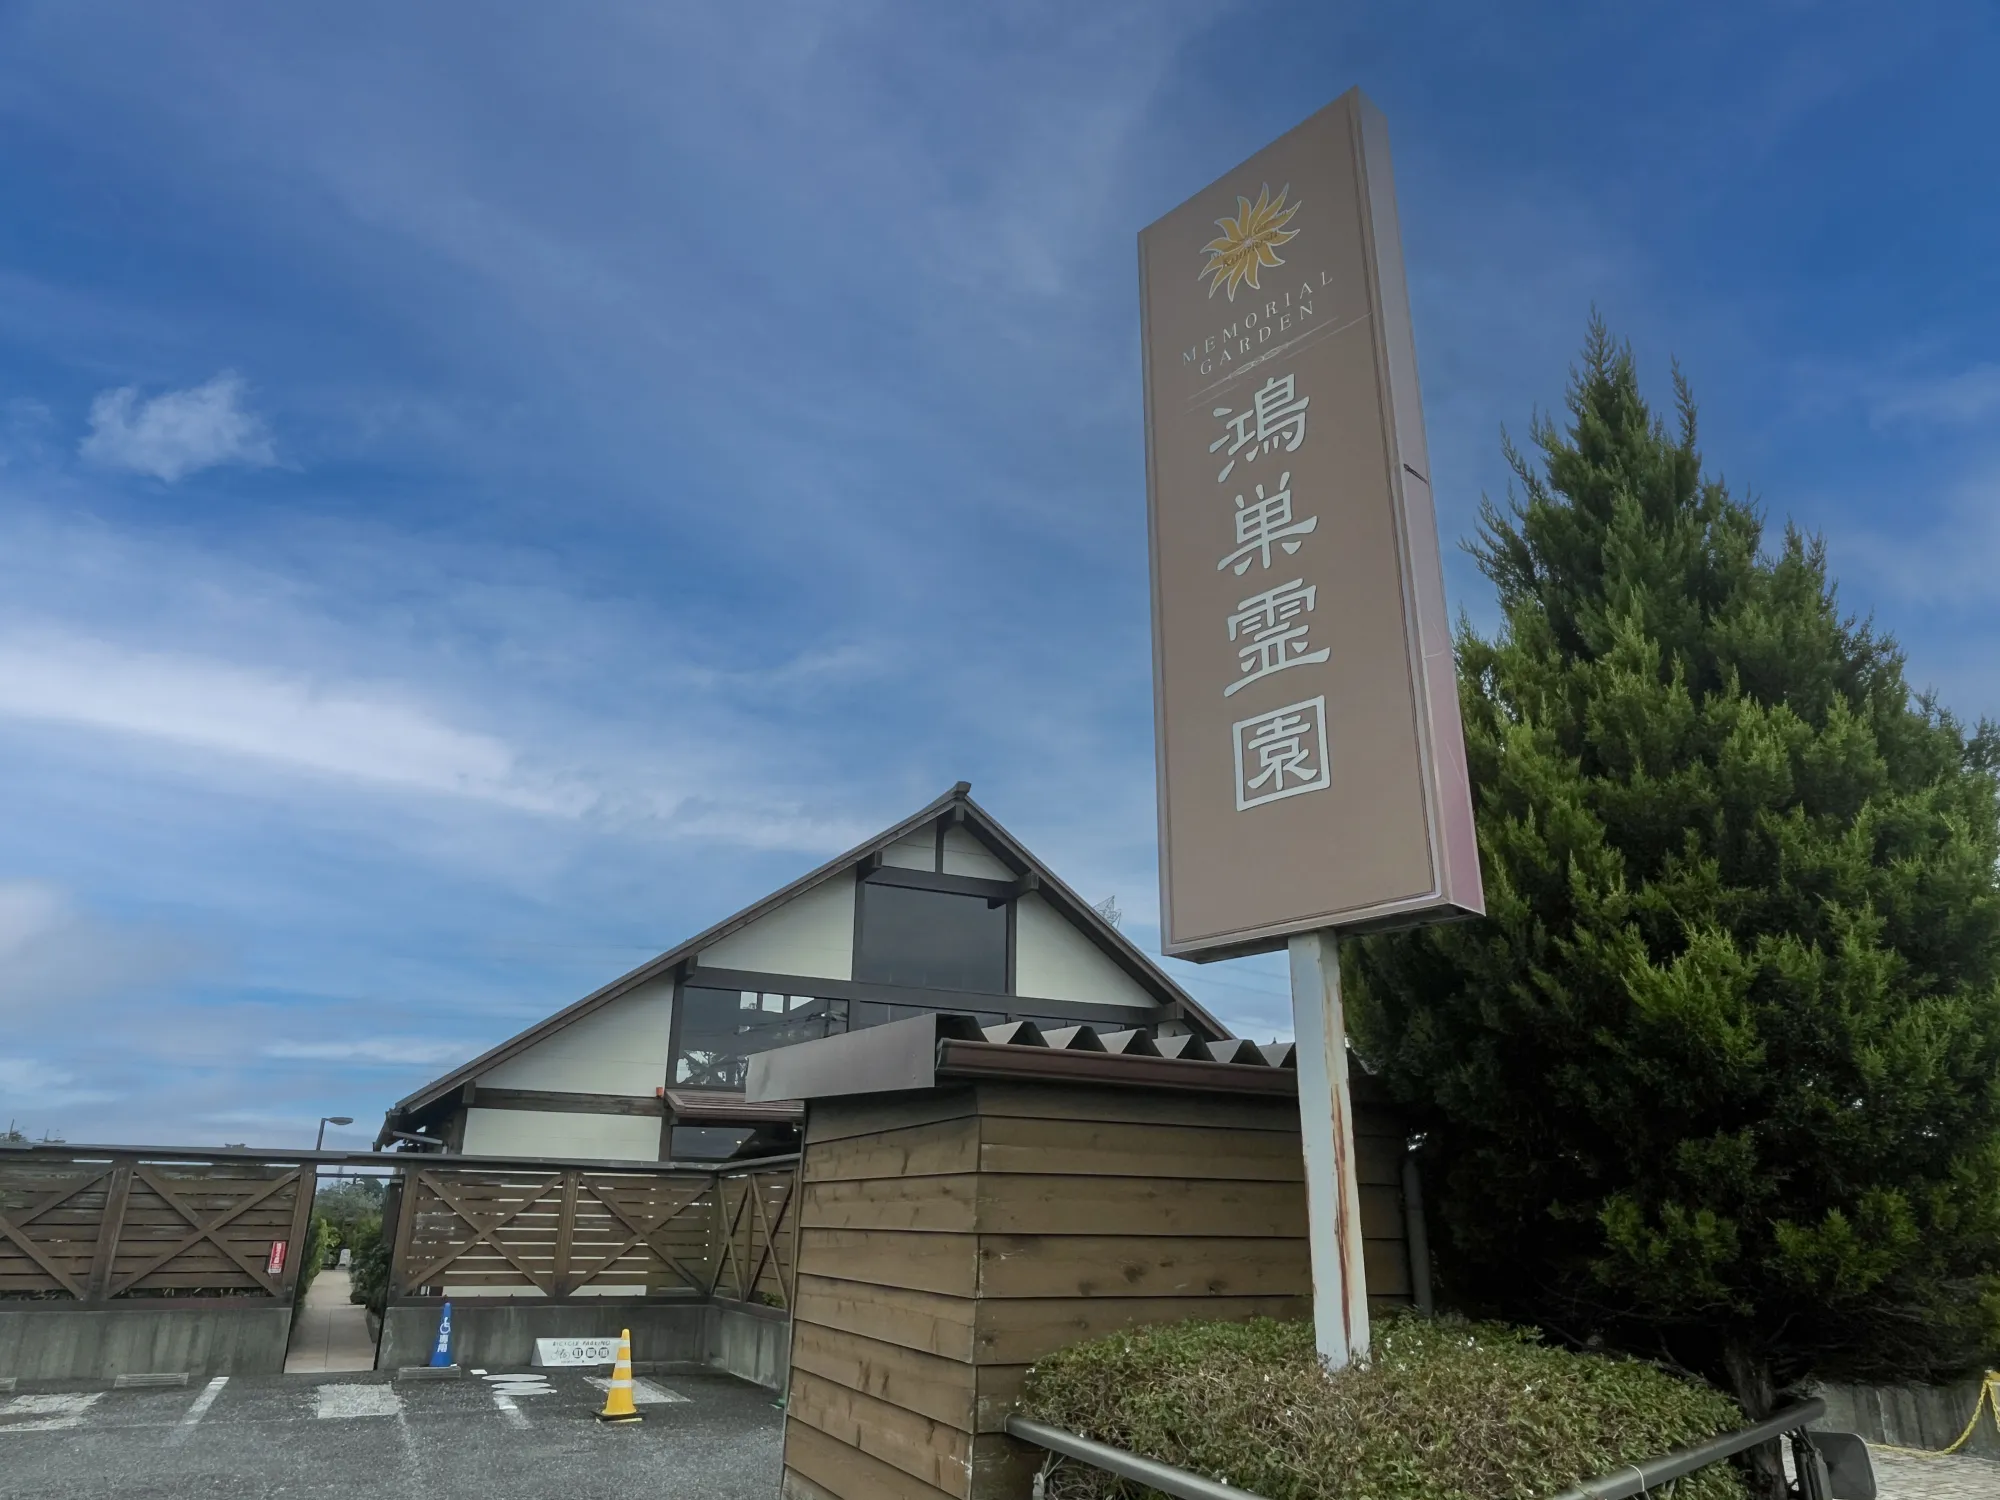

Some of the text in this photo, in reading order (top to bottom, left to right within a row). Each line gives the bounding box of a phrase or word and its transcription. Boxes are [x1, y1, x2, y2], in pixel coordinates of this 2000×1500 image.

[1182, 270, 1333, 366] MEMORIAL
[1200, 300, 1313, 375] GARDEN
[1208, 373, 1331, 812] 鴻巣霊園
